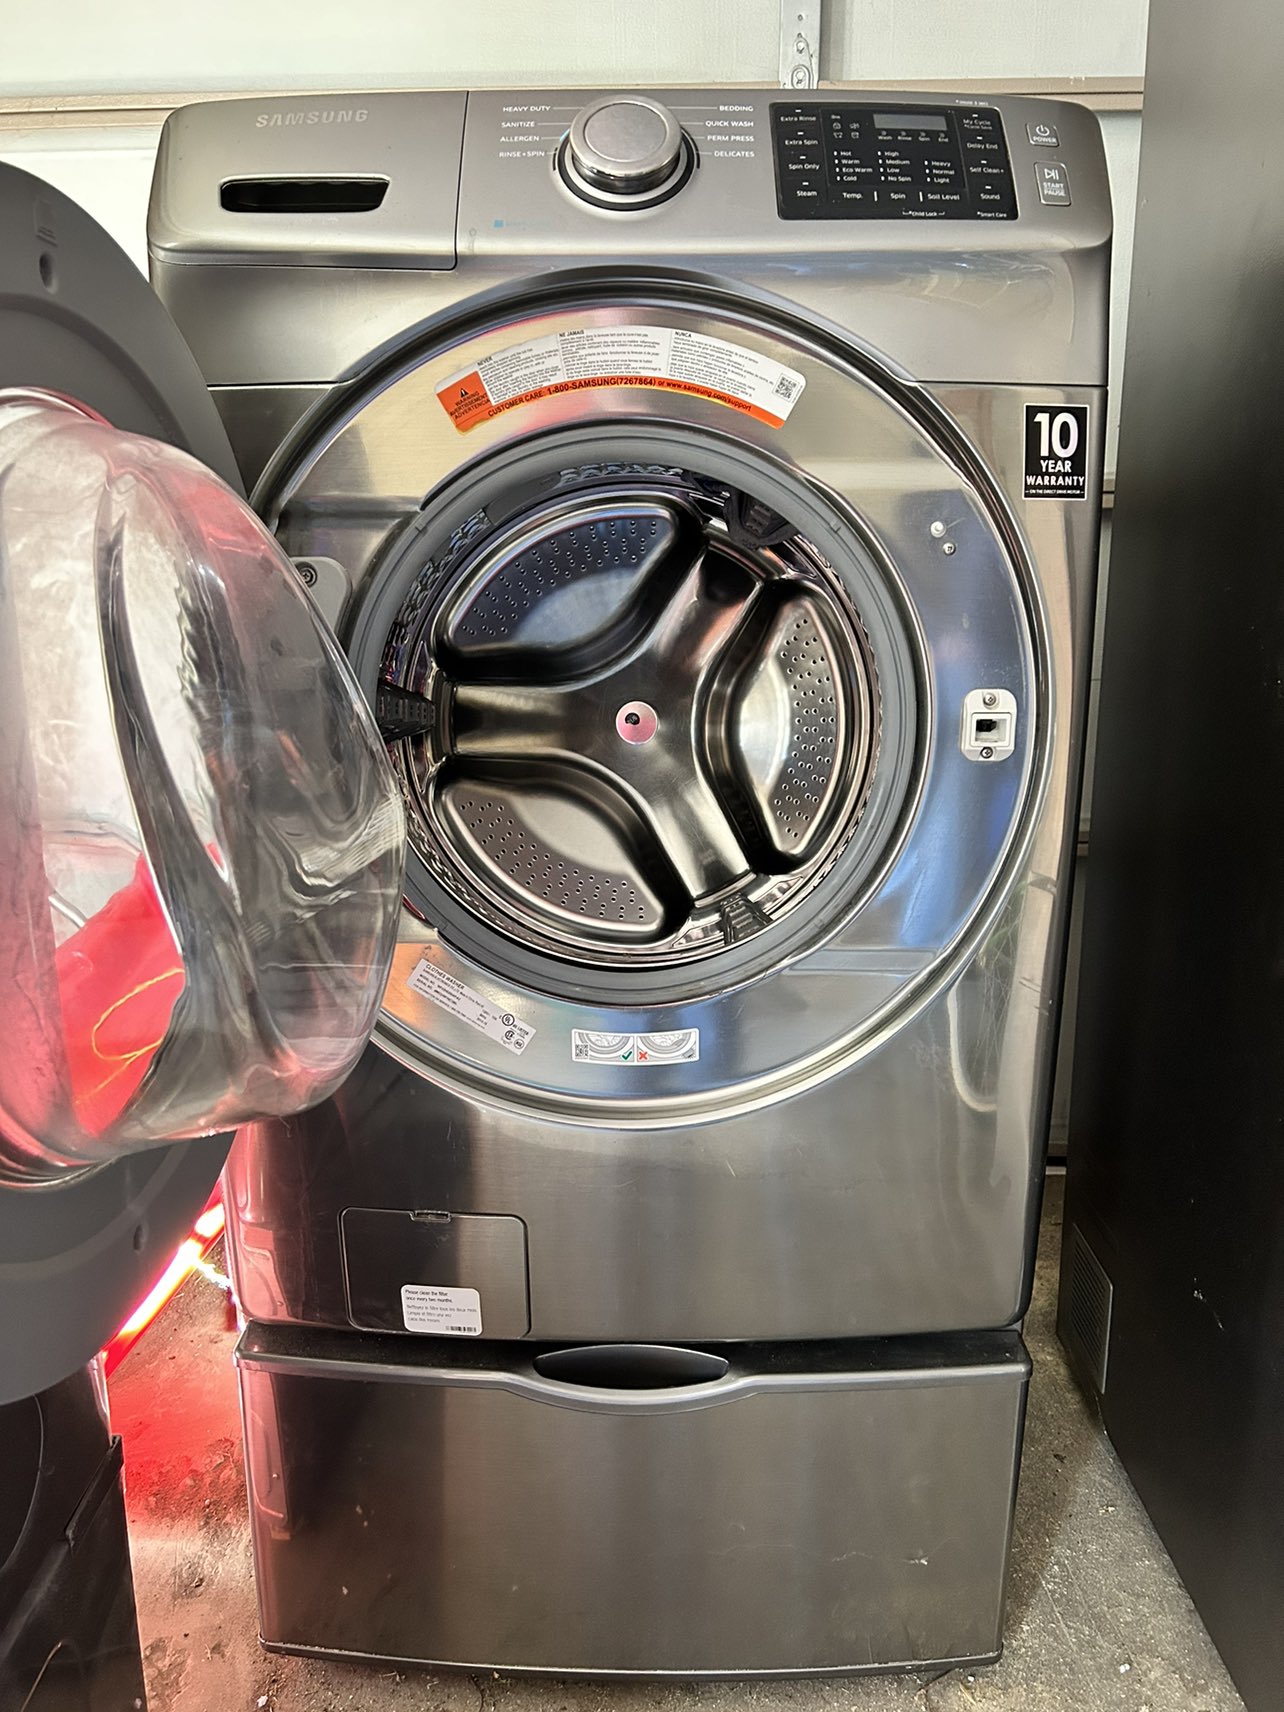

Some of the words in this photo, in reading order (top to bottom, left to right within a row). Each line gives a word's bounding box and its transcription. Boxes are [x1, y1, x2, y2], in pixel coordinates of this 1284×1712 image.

[255, 109, 369, 128] SAMSUNG
[566, 329, 584, 337] JAMAIS
[455, 391, 480, 407] WARNING
[487, 395, 525, 417] CUSTOMER
[524, 390, 546, 402] CARE:
[666, 381, 752, 412] www.samsung.com/support
[1033, 412, 1079, 458] 10
[1040, 459, 1072, 473] YEAR
[1026, 475, 1085, 486] WARRANTY
[425, 963, 446, 980] CLOTHES
[446, 976, 465, 990] WASHER
